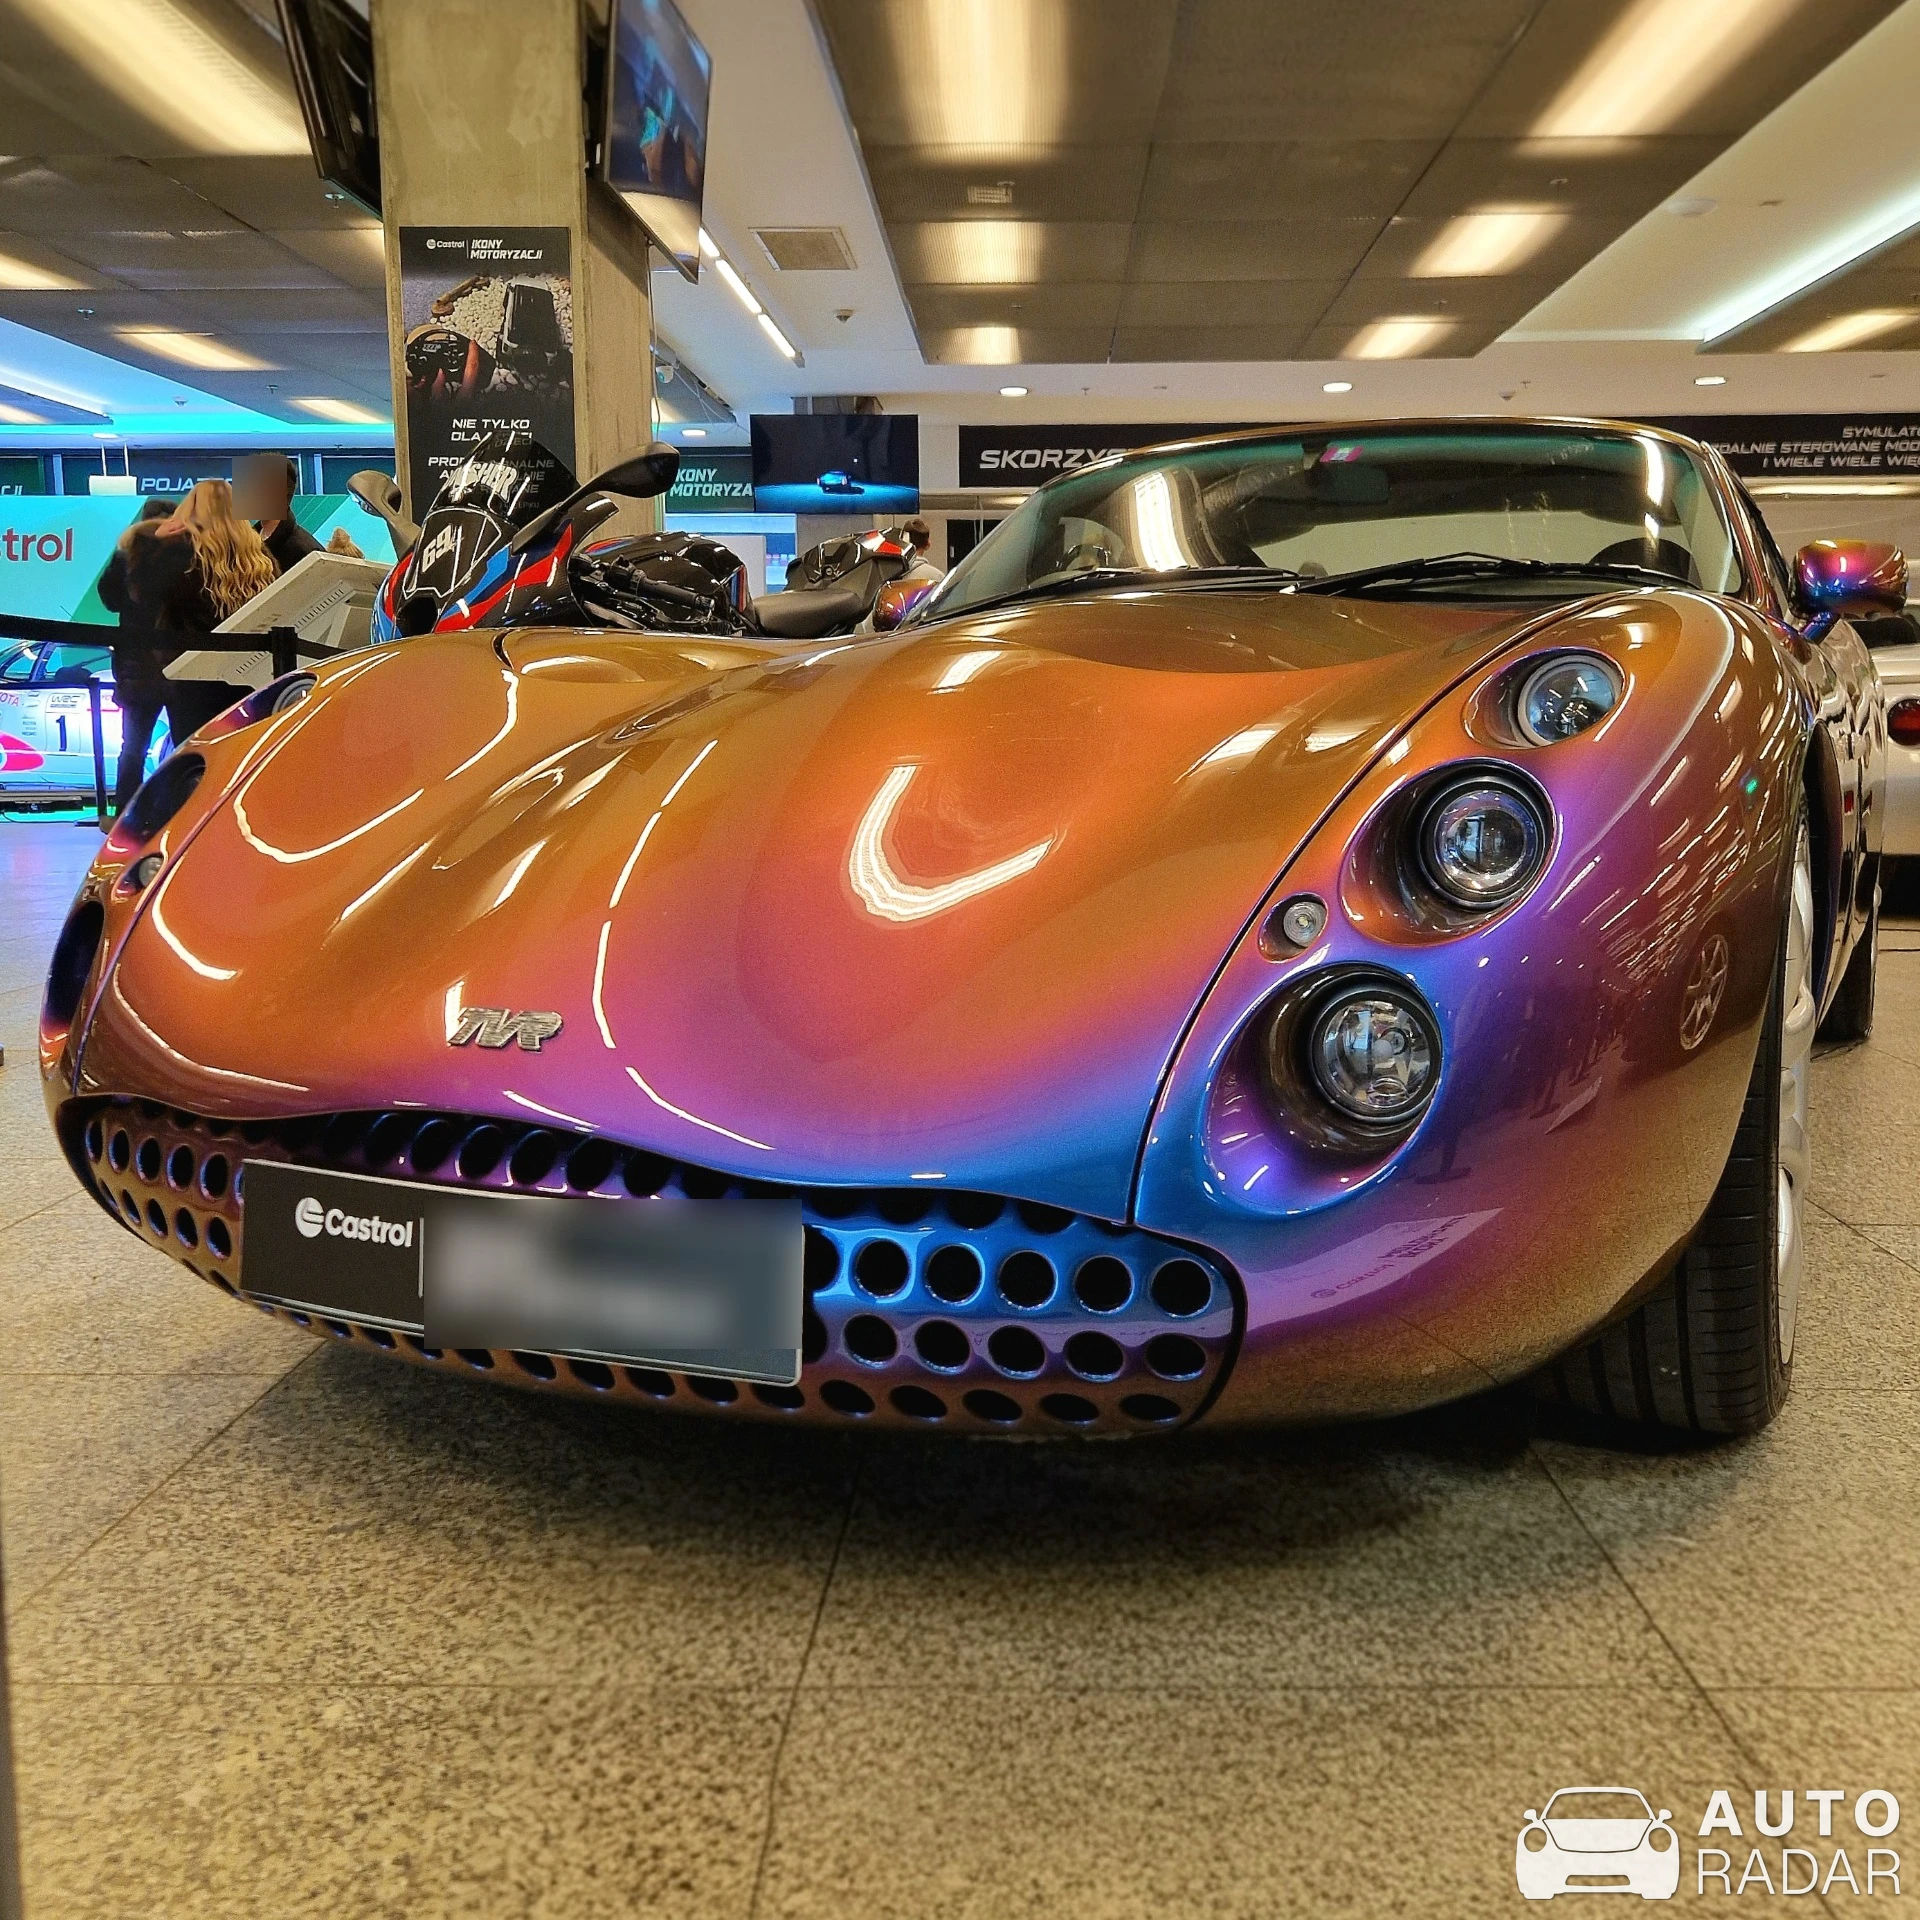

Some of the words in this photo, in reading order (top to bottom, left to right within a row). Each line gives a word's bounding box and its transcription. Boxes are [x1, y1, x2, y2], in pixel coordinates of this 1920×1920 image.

[436, 240, 465, 248] Castrol
[471, 239, 503, 249] IKONY
[470, 249, 543, 260] MOTORYZACJI
[452, 419, 477, 429] NIE
[482, 419, 531, 429] TYLKO
[1781, 440, 1881, 453] STEROWANE
[1773, 455, 1825, 467] WIELE
[1830, 454, 1882, 467] WIELE
[675, 468, 718, 482] KONY
[669, 483, 753, 497] MOTORYZA
[0, 527, 73, 562] trol
[56, 715, 67, 752] 1
[447, 1007, 563, 1052] TVR
[325, 1208, 414, 1248] Castrol
